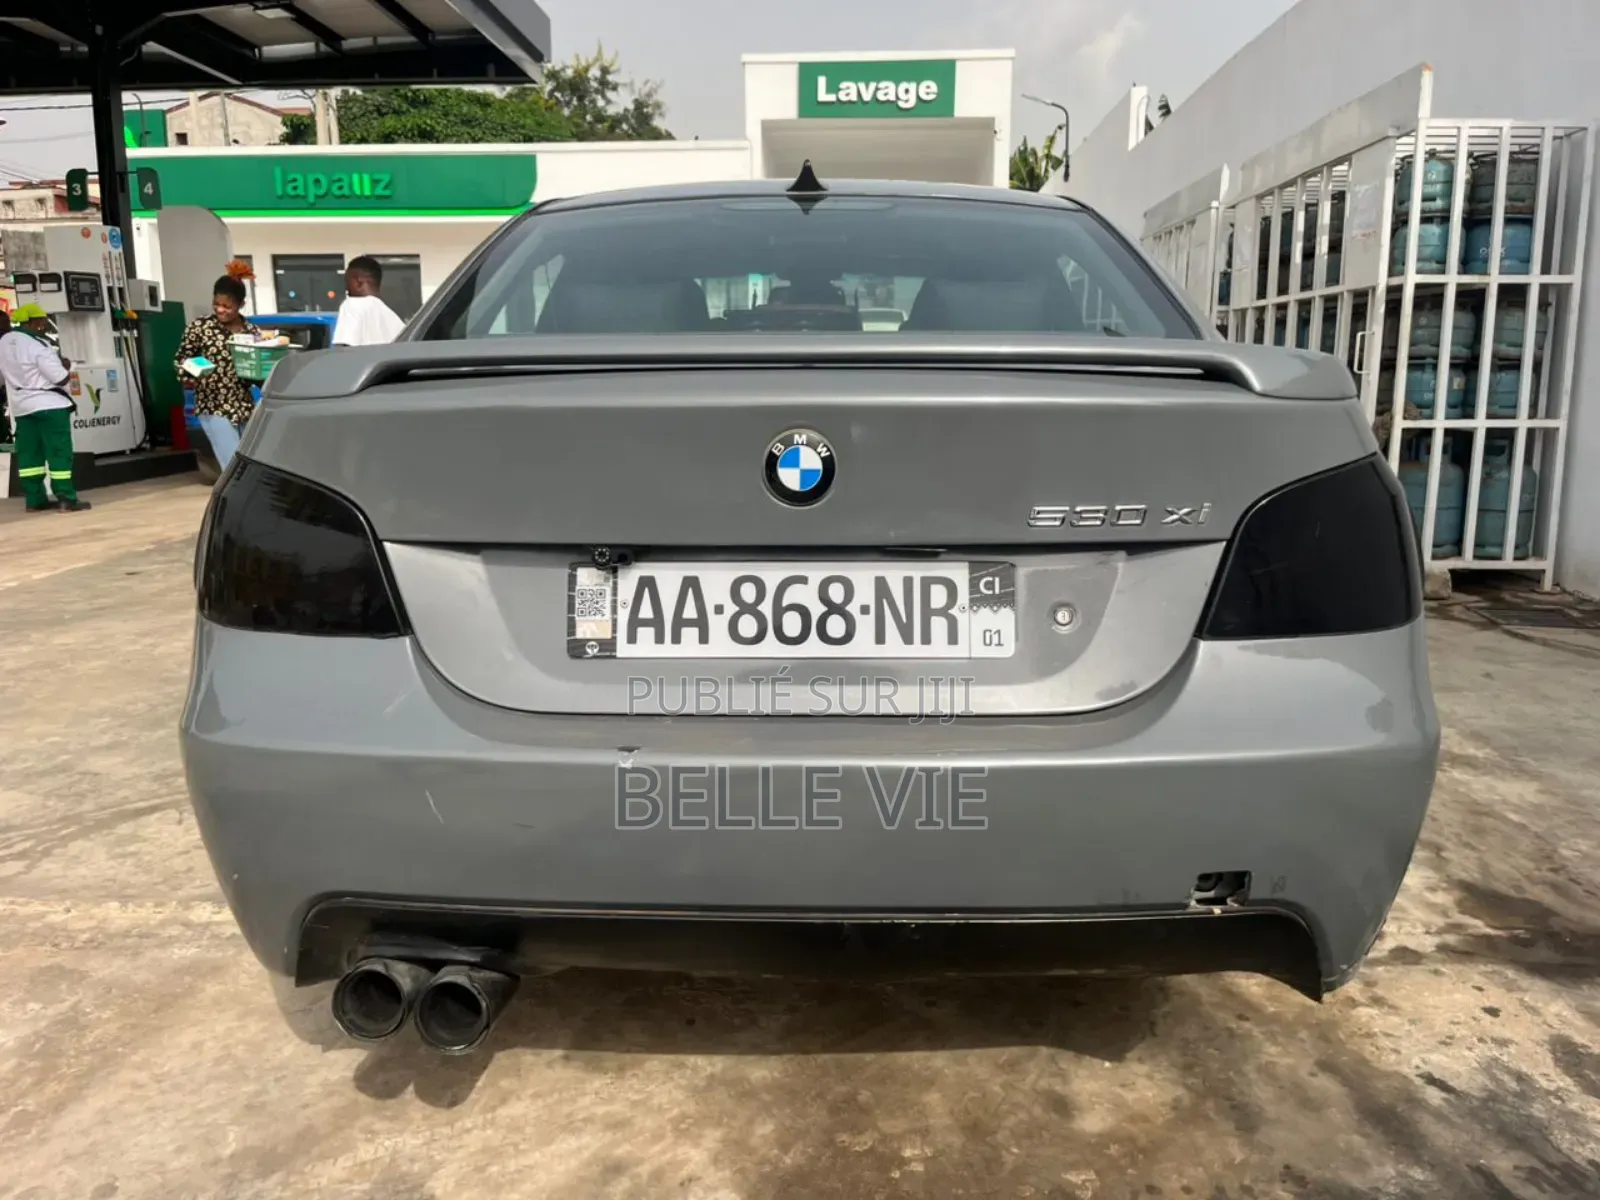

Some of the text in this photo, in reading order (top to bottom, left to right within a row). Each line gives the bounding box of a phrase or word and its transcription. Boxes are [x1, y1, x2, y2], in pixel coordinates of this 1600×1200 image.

[816, 75, 939, 109] Lavage
[71, 183, 82, 196] 3
[143, 182, 154, 195] 4
[771, 433, 831, 458] BMW
[1027, 504, 1148, 528] 530
[979, 576, 1000, 595] CI
[983, 629, 1005, 647] 01
